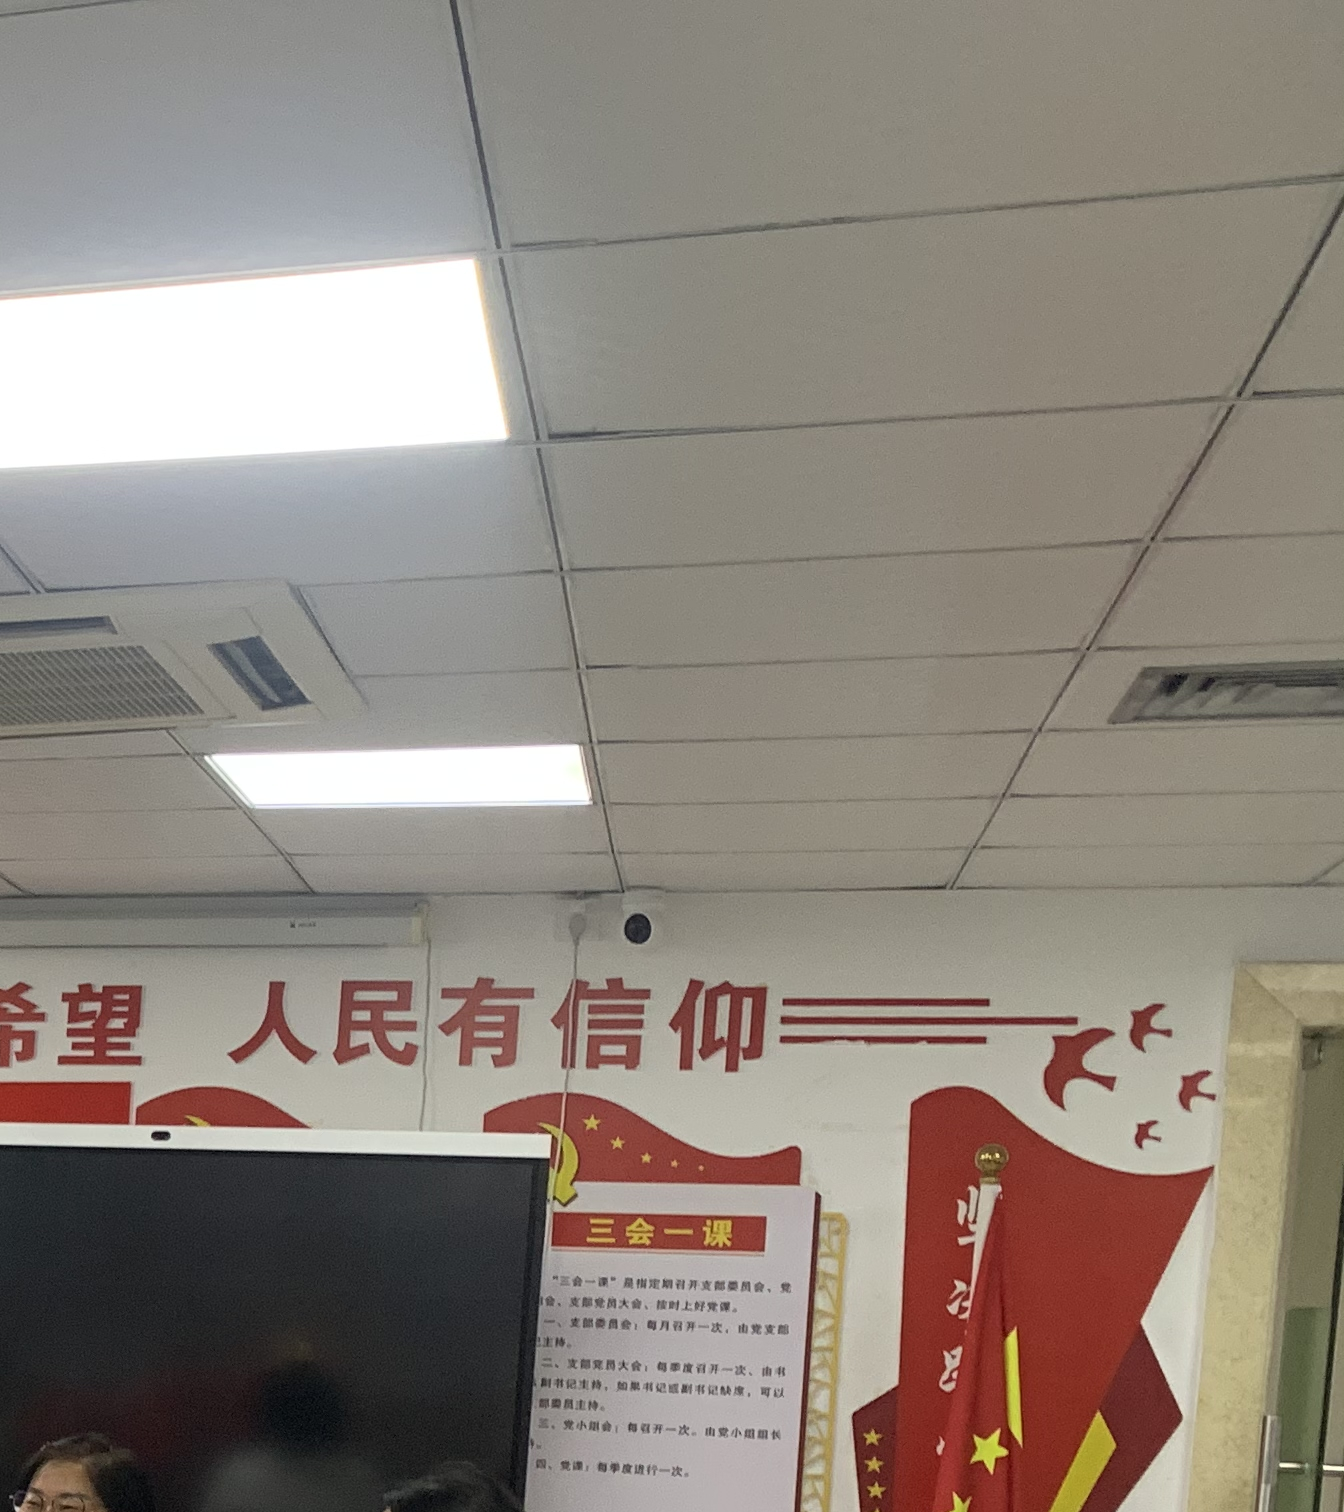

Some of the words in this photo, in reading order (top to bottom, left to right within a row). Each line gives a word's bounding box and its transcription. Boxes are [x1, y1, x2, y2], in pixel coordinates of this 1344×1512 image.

[226, 977, 769, 1072] 人民有信仰
[586, 1217, 733, 1248] 三会一课
